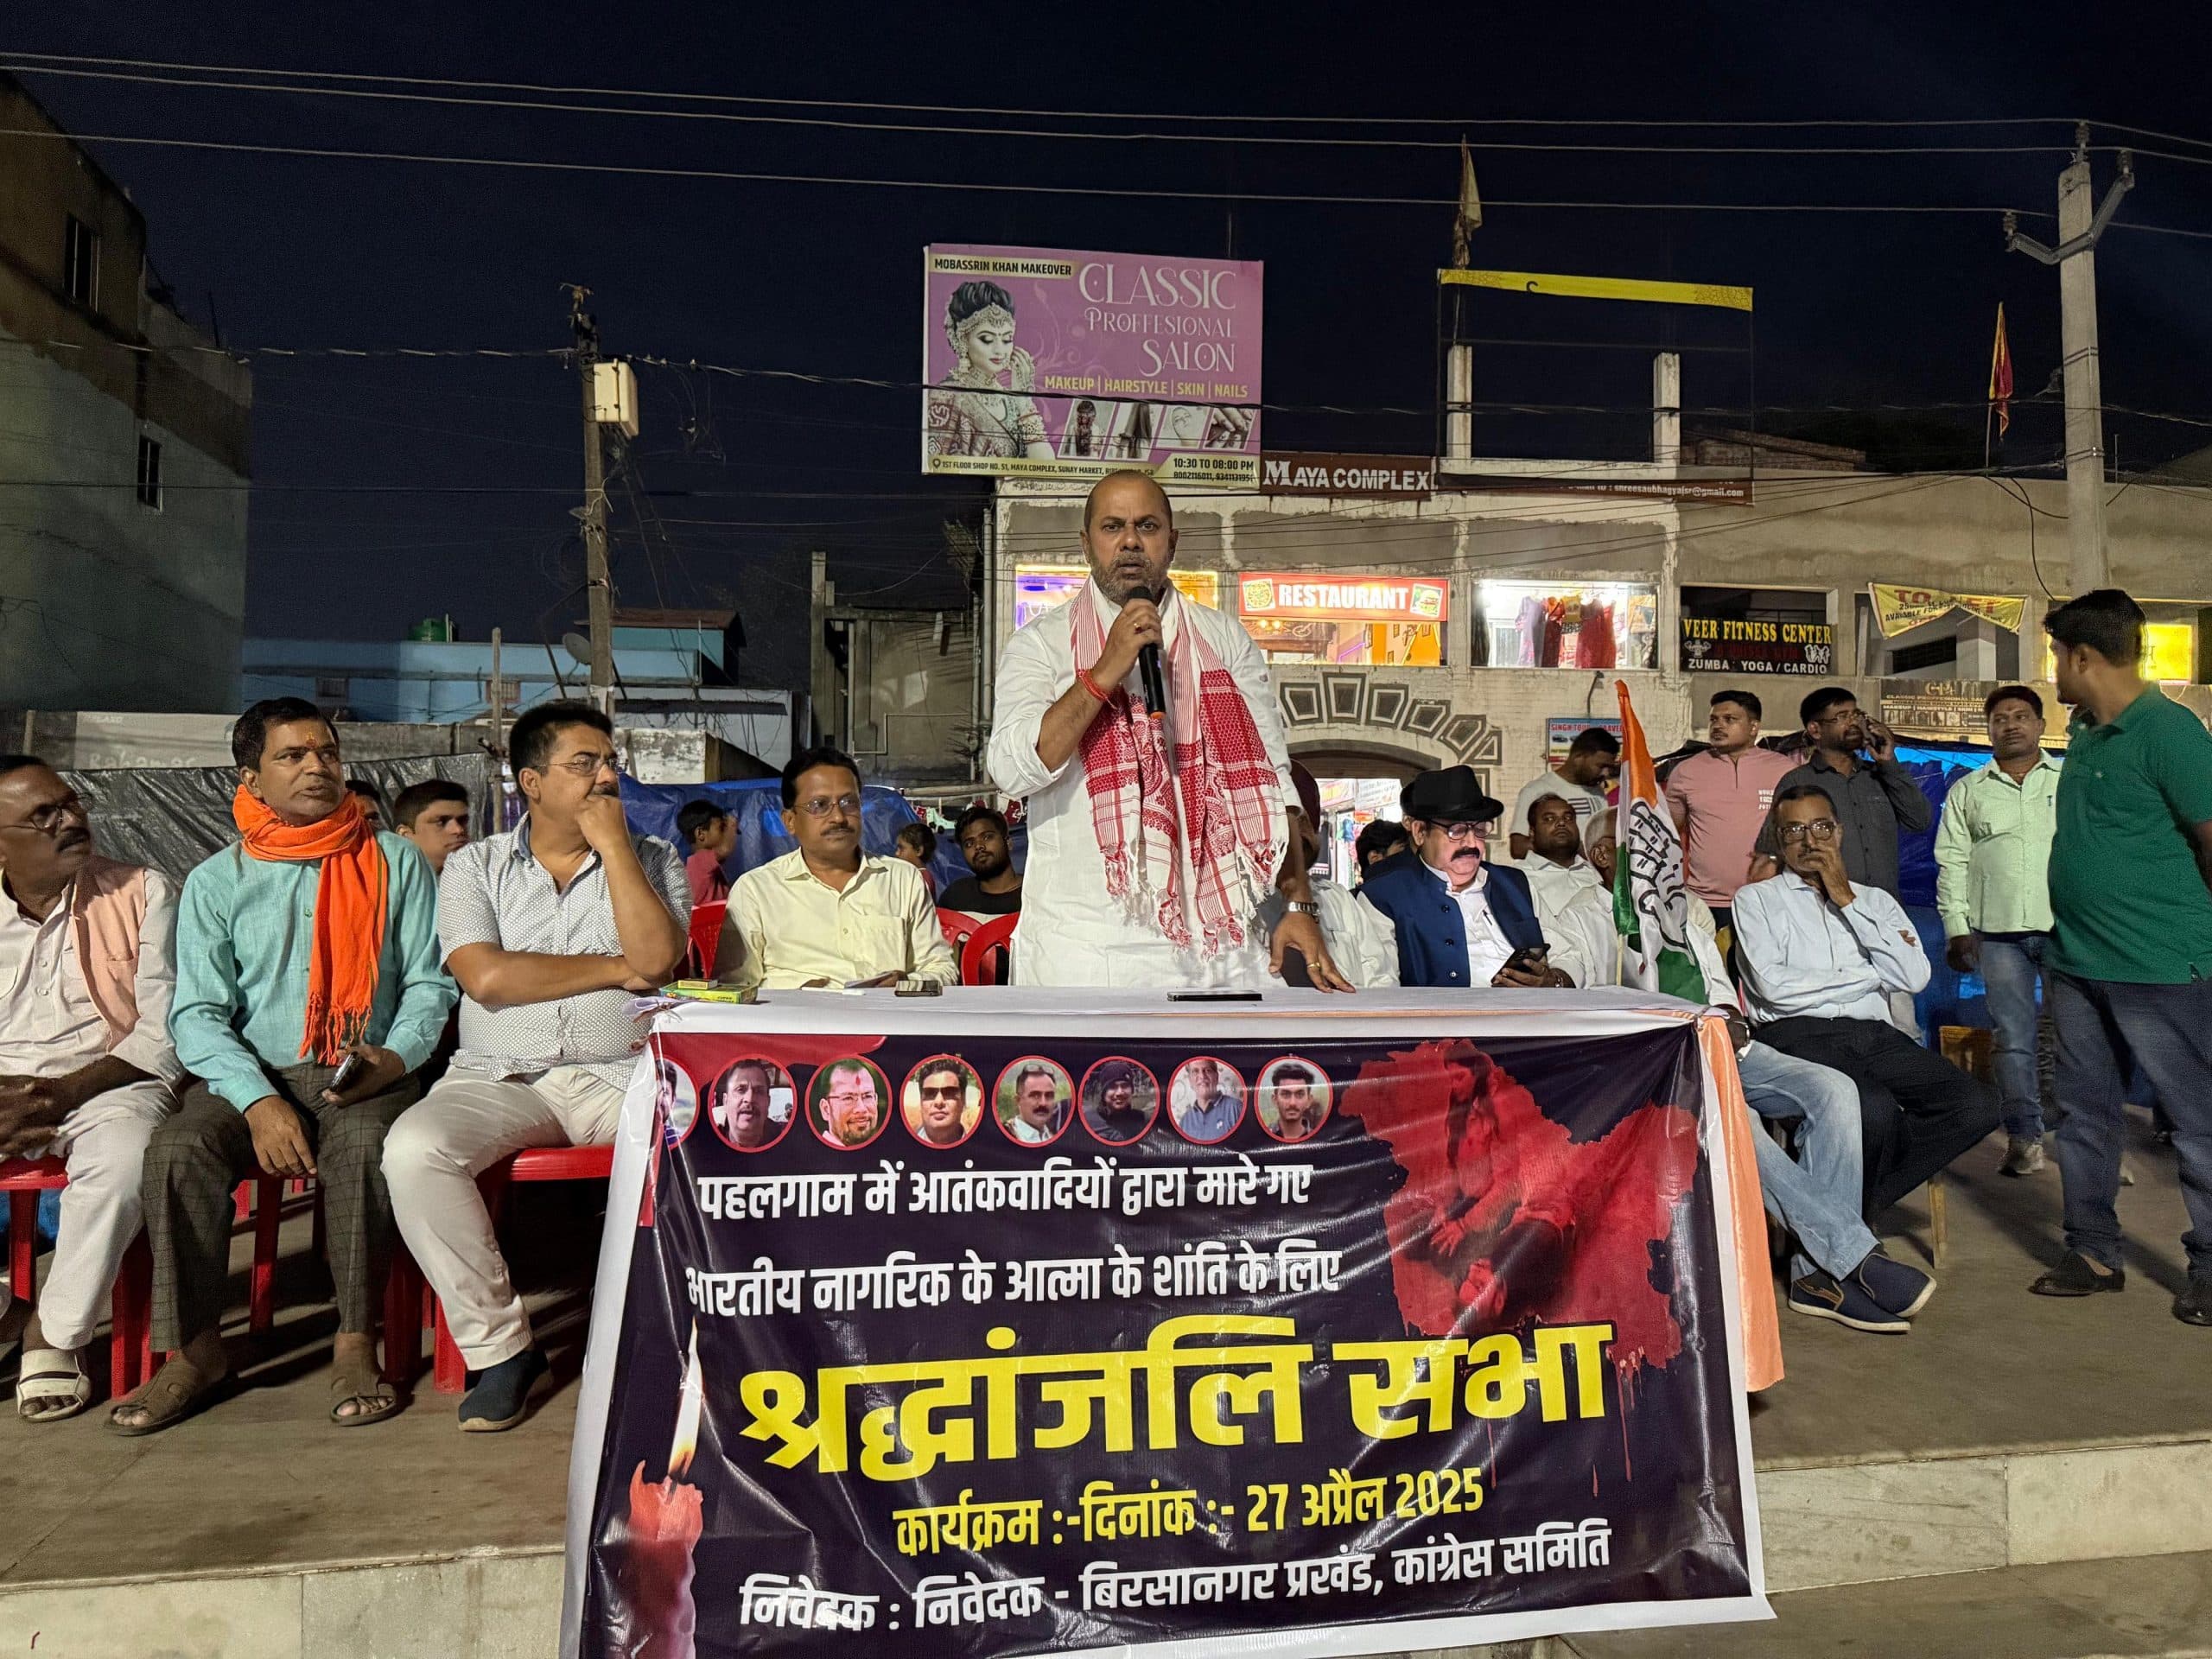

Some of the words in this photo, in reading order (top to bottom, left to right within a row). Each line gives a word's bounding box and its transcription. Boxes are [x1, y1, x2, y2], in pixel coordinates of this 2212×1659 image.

[934, 258, 989, 271] MOBASSRIN
[992, 261, 1019, 273] KHAN
[1020, 263, 1071, 276] MAKEOVER
[1078, 263, 1236, 309] CLASSIC
[1138, 339, 1236, 377] SALON
[1045, 376, 1094, 391] MAKEUP
[1104, 378, 1167, 395] HAIRSTYLE
[1177, 382, 1205, 396] SKIN
[1214, 385, 1249, 397] NAILS
[1029, 465, 1057, 474] COMPLEX,
[1174, 458, 1197, 468] 10:30
[1199, 460, 1210, 468] TO
[1213, 460, 1237, 470] 08:00
[1241, 461, 1254, 471] PM
[1262, 461, 1330, 488] MAYA
[1333, 468, 1429, 490] COMPLEX
[1278, 584, 1408, 608] RESTAURANT
[1684, 619, 1718, 639] VEER
[1723, 621, 1777, 642] FITNESS
[1783, 624, 1832, 645] CENTER
[1688, 658, 1729, 670] ZUMBA
[1741, 661, 1773, 672] YOGA
[1783, 664, 1827, 674] CARDIO
[696, 1173, 857, 1220] पहलगाम
[862, 1159, 905, 1214] में
[908, 1156, 1117, 1213] आतंकवादियों
[1119, 1167, 1188, 1216] द्वारा
[1192, 1154, 1260, 1205] मारे
[1264, 1164, 1314, 1204] गए
[685, 1256, 805, 1317] भारतीय
[810, 1250, 954, 1312] नागरिक
[958, 1249, 996, 1305] के
[1005, 1257, 1103, 1302] आत्मा
[1108, 1243, 1145, 1298] के
[1153, 1241, 1230, 1296] शांति
[1233, 1239, 1270, 1293] के
[1274, 1238, 1343, 1292] लिए
[739, 1314, 1313, 1482] श्रद्धांजलि
[1332, 1322, 1616, 1437] सभा
[893, 1489, 1043, 1556] कार्यक्रम
[1247, 1484, 1289, 1532] 27
[1300, 1468, 1388, 1527] अप्रैल
[1395, 1467, 1484, 1519] 2025
[739, 1573, 880, 1631] निवेदक
[912, 1571, 1046, 1628] निवेदक
[1078, 1561, 1279, 1611] बिरसानगर
[1282, 1544, 1384, 1597] प्रखंड,
[1390, 1533, 1496, 1586] कांग्रेस
[1499, 1517, 1612, 1574] समिति
